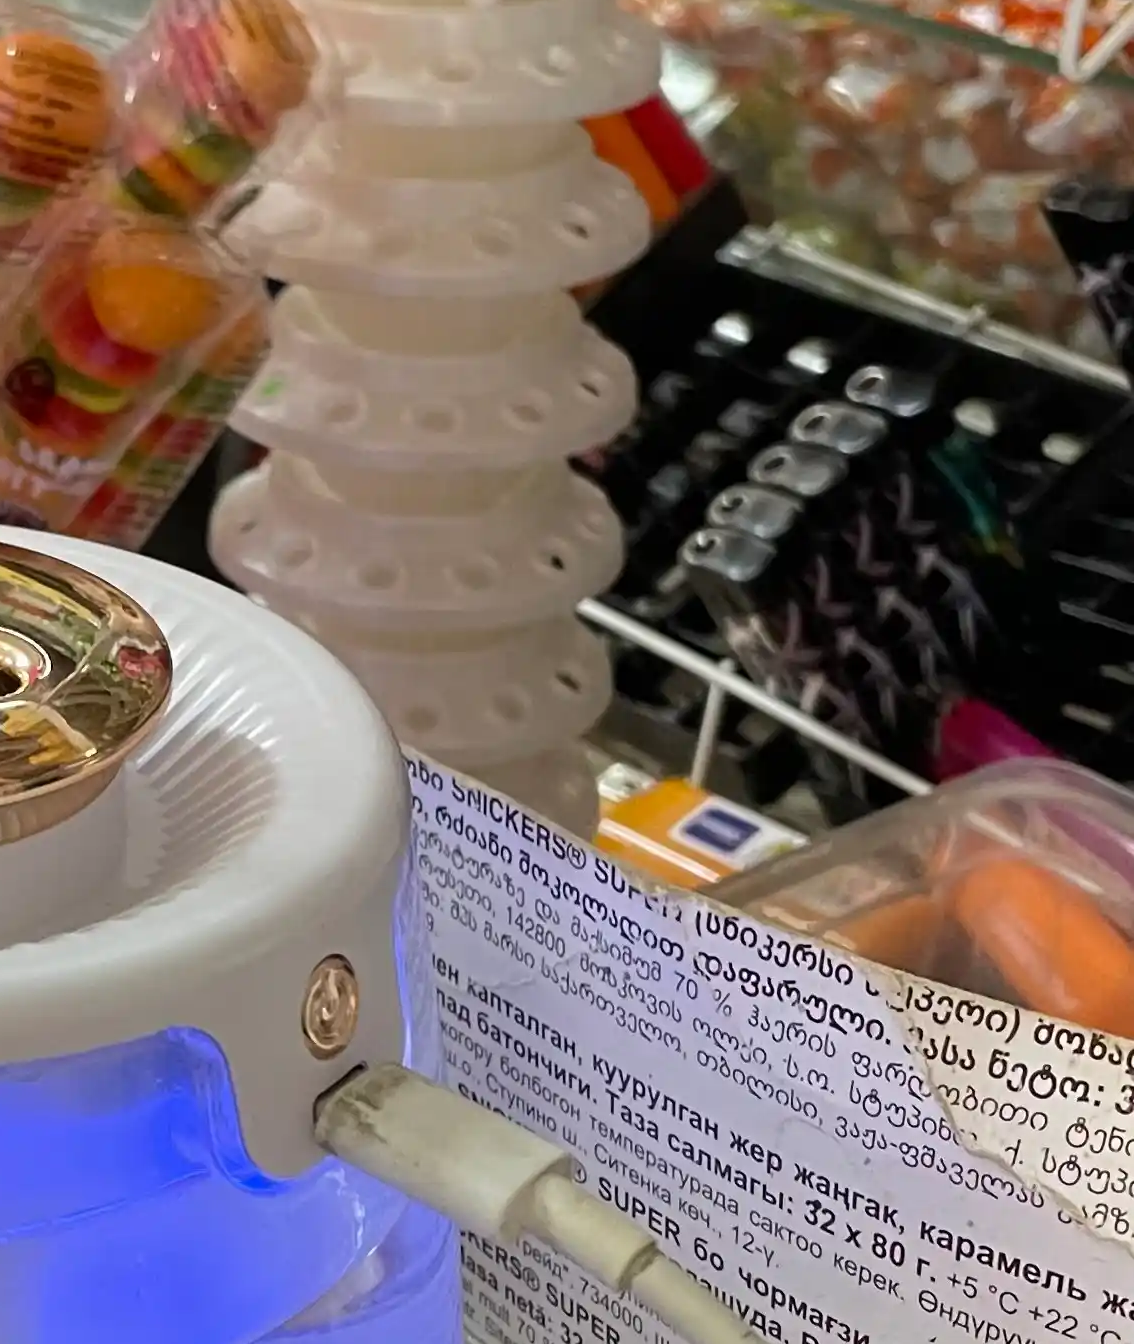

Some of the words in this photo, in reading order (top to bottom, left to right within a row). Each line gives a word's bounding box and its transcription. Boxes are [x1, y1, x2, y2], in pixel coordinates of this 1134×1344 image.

[466, 976, 583, 1067] капталган,
[592, 1053, 719, 1141] куурулган
[729, 1130, 783, 1179] жер
[793, 1163, 906, 1236] жаңгак,
[920, 1220, 1088, 1302] карамель
[477, 1011, 598, 1105] батончиги.
[605, 1088, 660, 1143] Таза
[667, 1133, 795, 1217] салмагы:
[803, 1199, 837, 1237] 32
[871, 1232, 906, 1268] 80
[916, 1257, 937, 1284] г.
[946, 1272, 979, 1300] +5
[1028, 1306, 1079, 1341] +22
[485, 1072, 558, 1133] Ступино
[594, 1142, 672, 1208] Ситенка
[500, 1055, 581, 1122] болбогон
[589, 1114, 740, 1217] температурада
[749, 1209, 823, 1260] сактоо
[833, 1252, 905, 1302] керек.
[598, 1176, 682, 1249] SUPER
[693, 1236, 725, 1272] бо
[517, 1316, 536, 1344] 70
